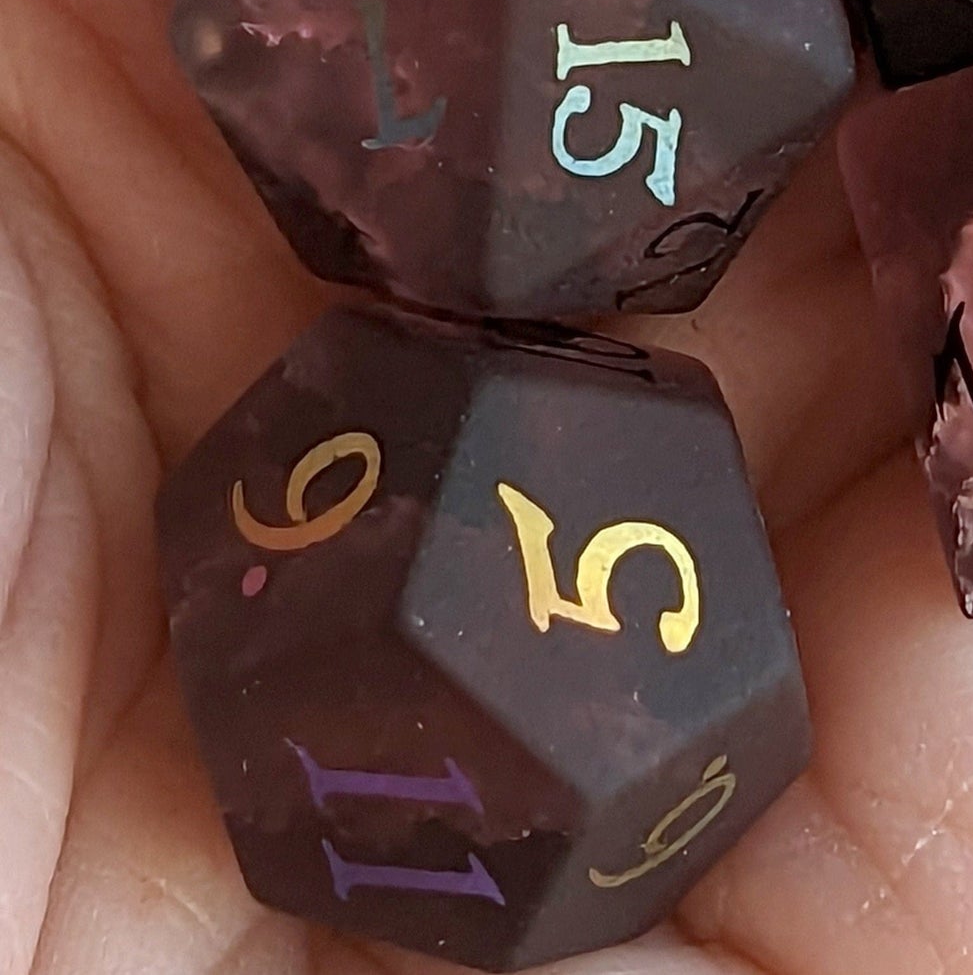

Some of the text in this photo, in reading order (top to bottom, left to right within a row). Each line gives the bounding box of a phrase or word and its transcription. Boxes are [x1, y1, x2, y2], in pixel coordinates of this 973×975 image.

[551, 20, 692, 207] 15
[497, 482, 700, 653] 5
[283, 736, 506, 907] 11
